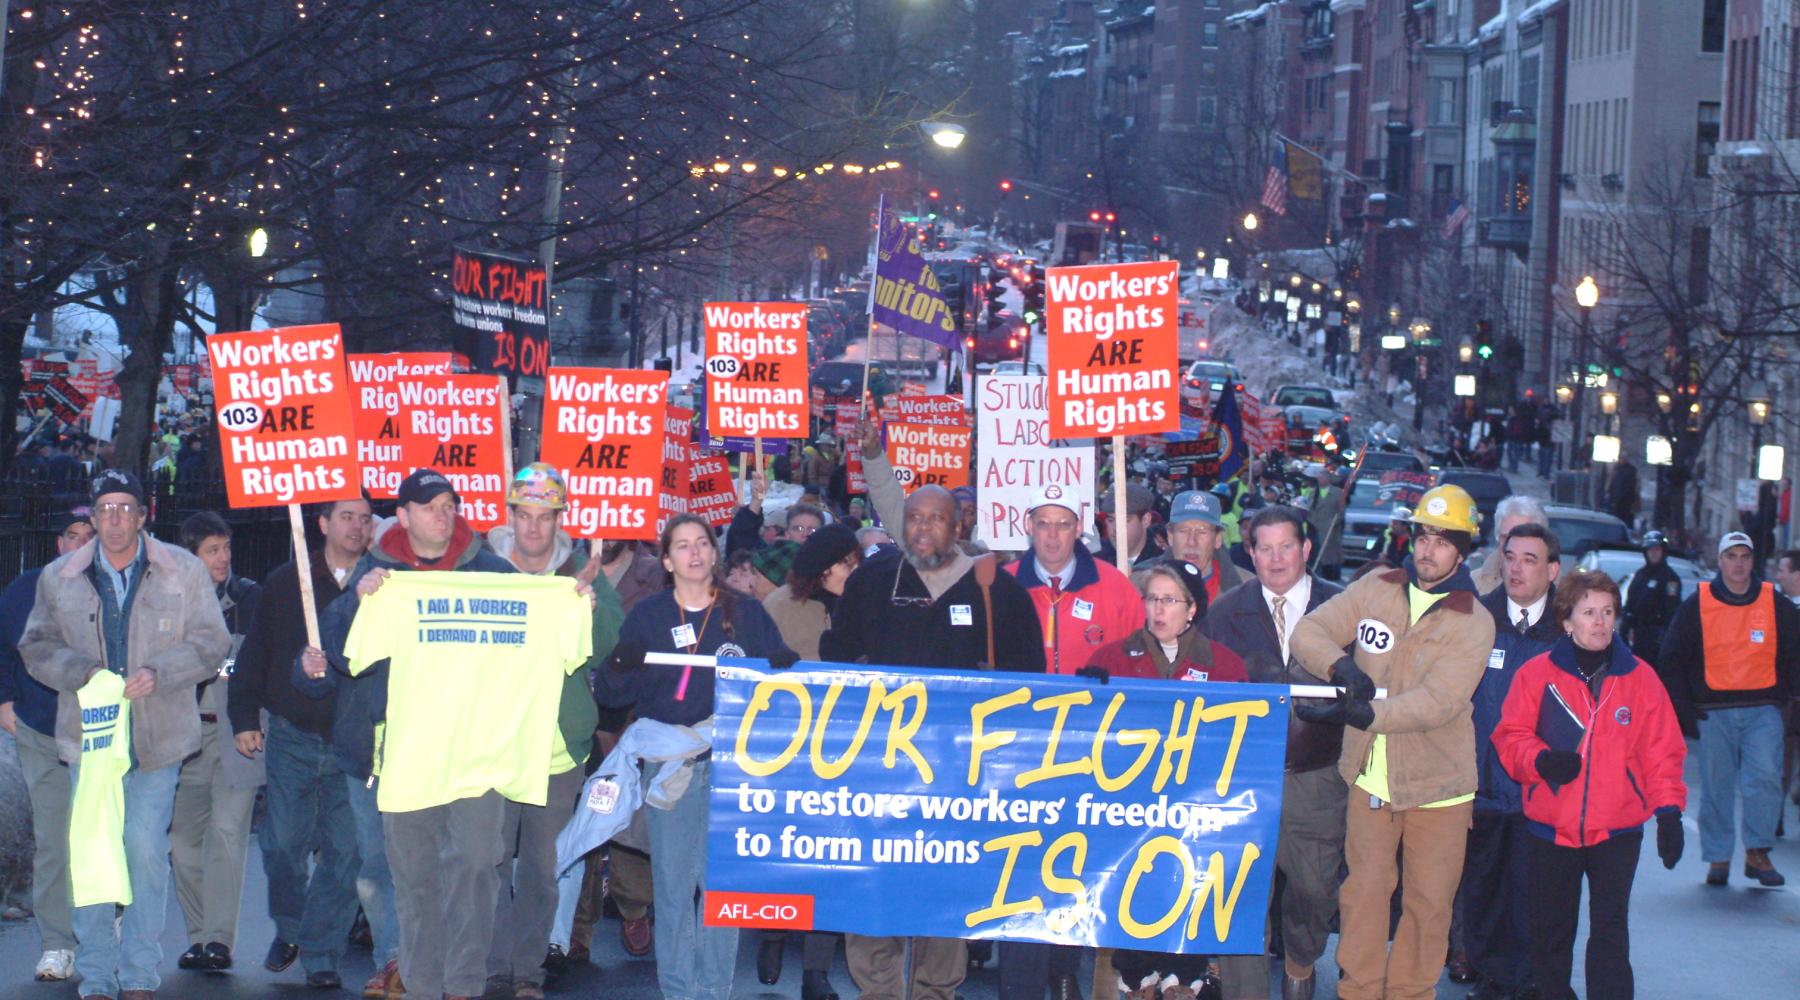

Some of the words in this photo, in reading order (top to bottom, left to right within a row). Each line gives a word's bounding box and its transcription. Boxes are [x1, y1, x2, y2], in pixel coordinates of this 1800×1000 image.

[453, 255, 485, 298] OUR
[488, 263, 546, 308] FIGHT
[1049, 271, 1175, 303] Workers'
[476, 317, 503, 333] unions
[514, 306, 546, 325] freedom
[705, 306, 806, 329] Workers'
[1063, 303, 1164, 340] Rights
[211, 334, 339, 369] Workers'
[492, 331, 516, 371] IS
[520, 336, 549, 377] ON
[717, 331, 797, 360] Rights
[1087, 339, 1144, 367] ARE
[709, 360, 737, 373] 103
[736, 362, 781, 382] ARE
[1057, 368, 1171, 396] Human
[229, 368, 334, 405] Rights
[399, 381, 500, 406] Workers'
[549, 375, 666, 403] Workers'
[714, 382, 803, 404] Human
[361, 387, 399, 416] Rig
[1064, 397, 1166, 433] Rights
[222, 407, 258, 426] 103
[258, 405, 315, 433] ARE
[411, 410, 494, 442] Rights
[558, 406, 652, 442] Rights
[665, 410, 691, 436] kers'
[719, 407, 799, 435] Rights
[996, 418, 1069, 447] LABO
[231, 435, 348, 463] Human
[888, 425, 971, 448] Workers'
[432, 444, 477, 467] ARE
[576, 444, 631, 469] ARE
[896, 447, 963, 472] Rights
[241, 464, 346, 500] Rights
[363, 466, 401, 496] Rig
[895, 470, 912, 481] 03
[984, 457, 1082, 488] ACTION
[459, 496, 499, 521] hts
[659, 493, 688, 513] man
[689, 491, 734, 509] uman
[417, 599, 423, 615] I
[428, 598, 450, 615] AM
[454, 598, 465, 614] A
[469, 598, 528, 617] WORKER
[418, 629, 424, 643] I
[427, 628, 477, 643] DEMAND
[480, 629, 488, 644] A
[492, 630, 526, 645] VOICE
[1360, 623, 1390, 650] 103
[82, 703, 120, 724] ORKER
[735, 677, 934, 785] OUR
[967, 686, 1270, 797] FIGHT
[736, 782, 775, 814] to
[785, 786, 909, 818] restore
[919, 789, 1066, 825] workers'
[1075, 792, 1224, 832] freedom
[735, 827, 771, 857] to
[780, 825, 861, 861] form
[872, 829, 980, 864] unions
[965, 830, 1089, 931] IS
[1117, 834, 1261, 942] ON
[717, 903, 798, 921] AFL-CIO
